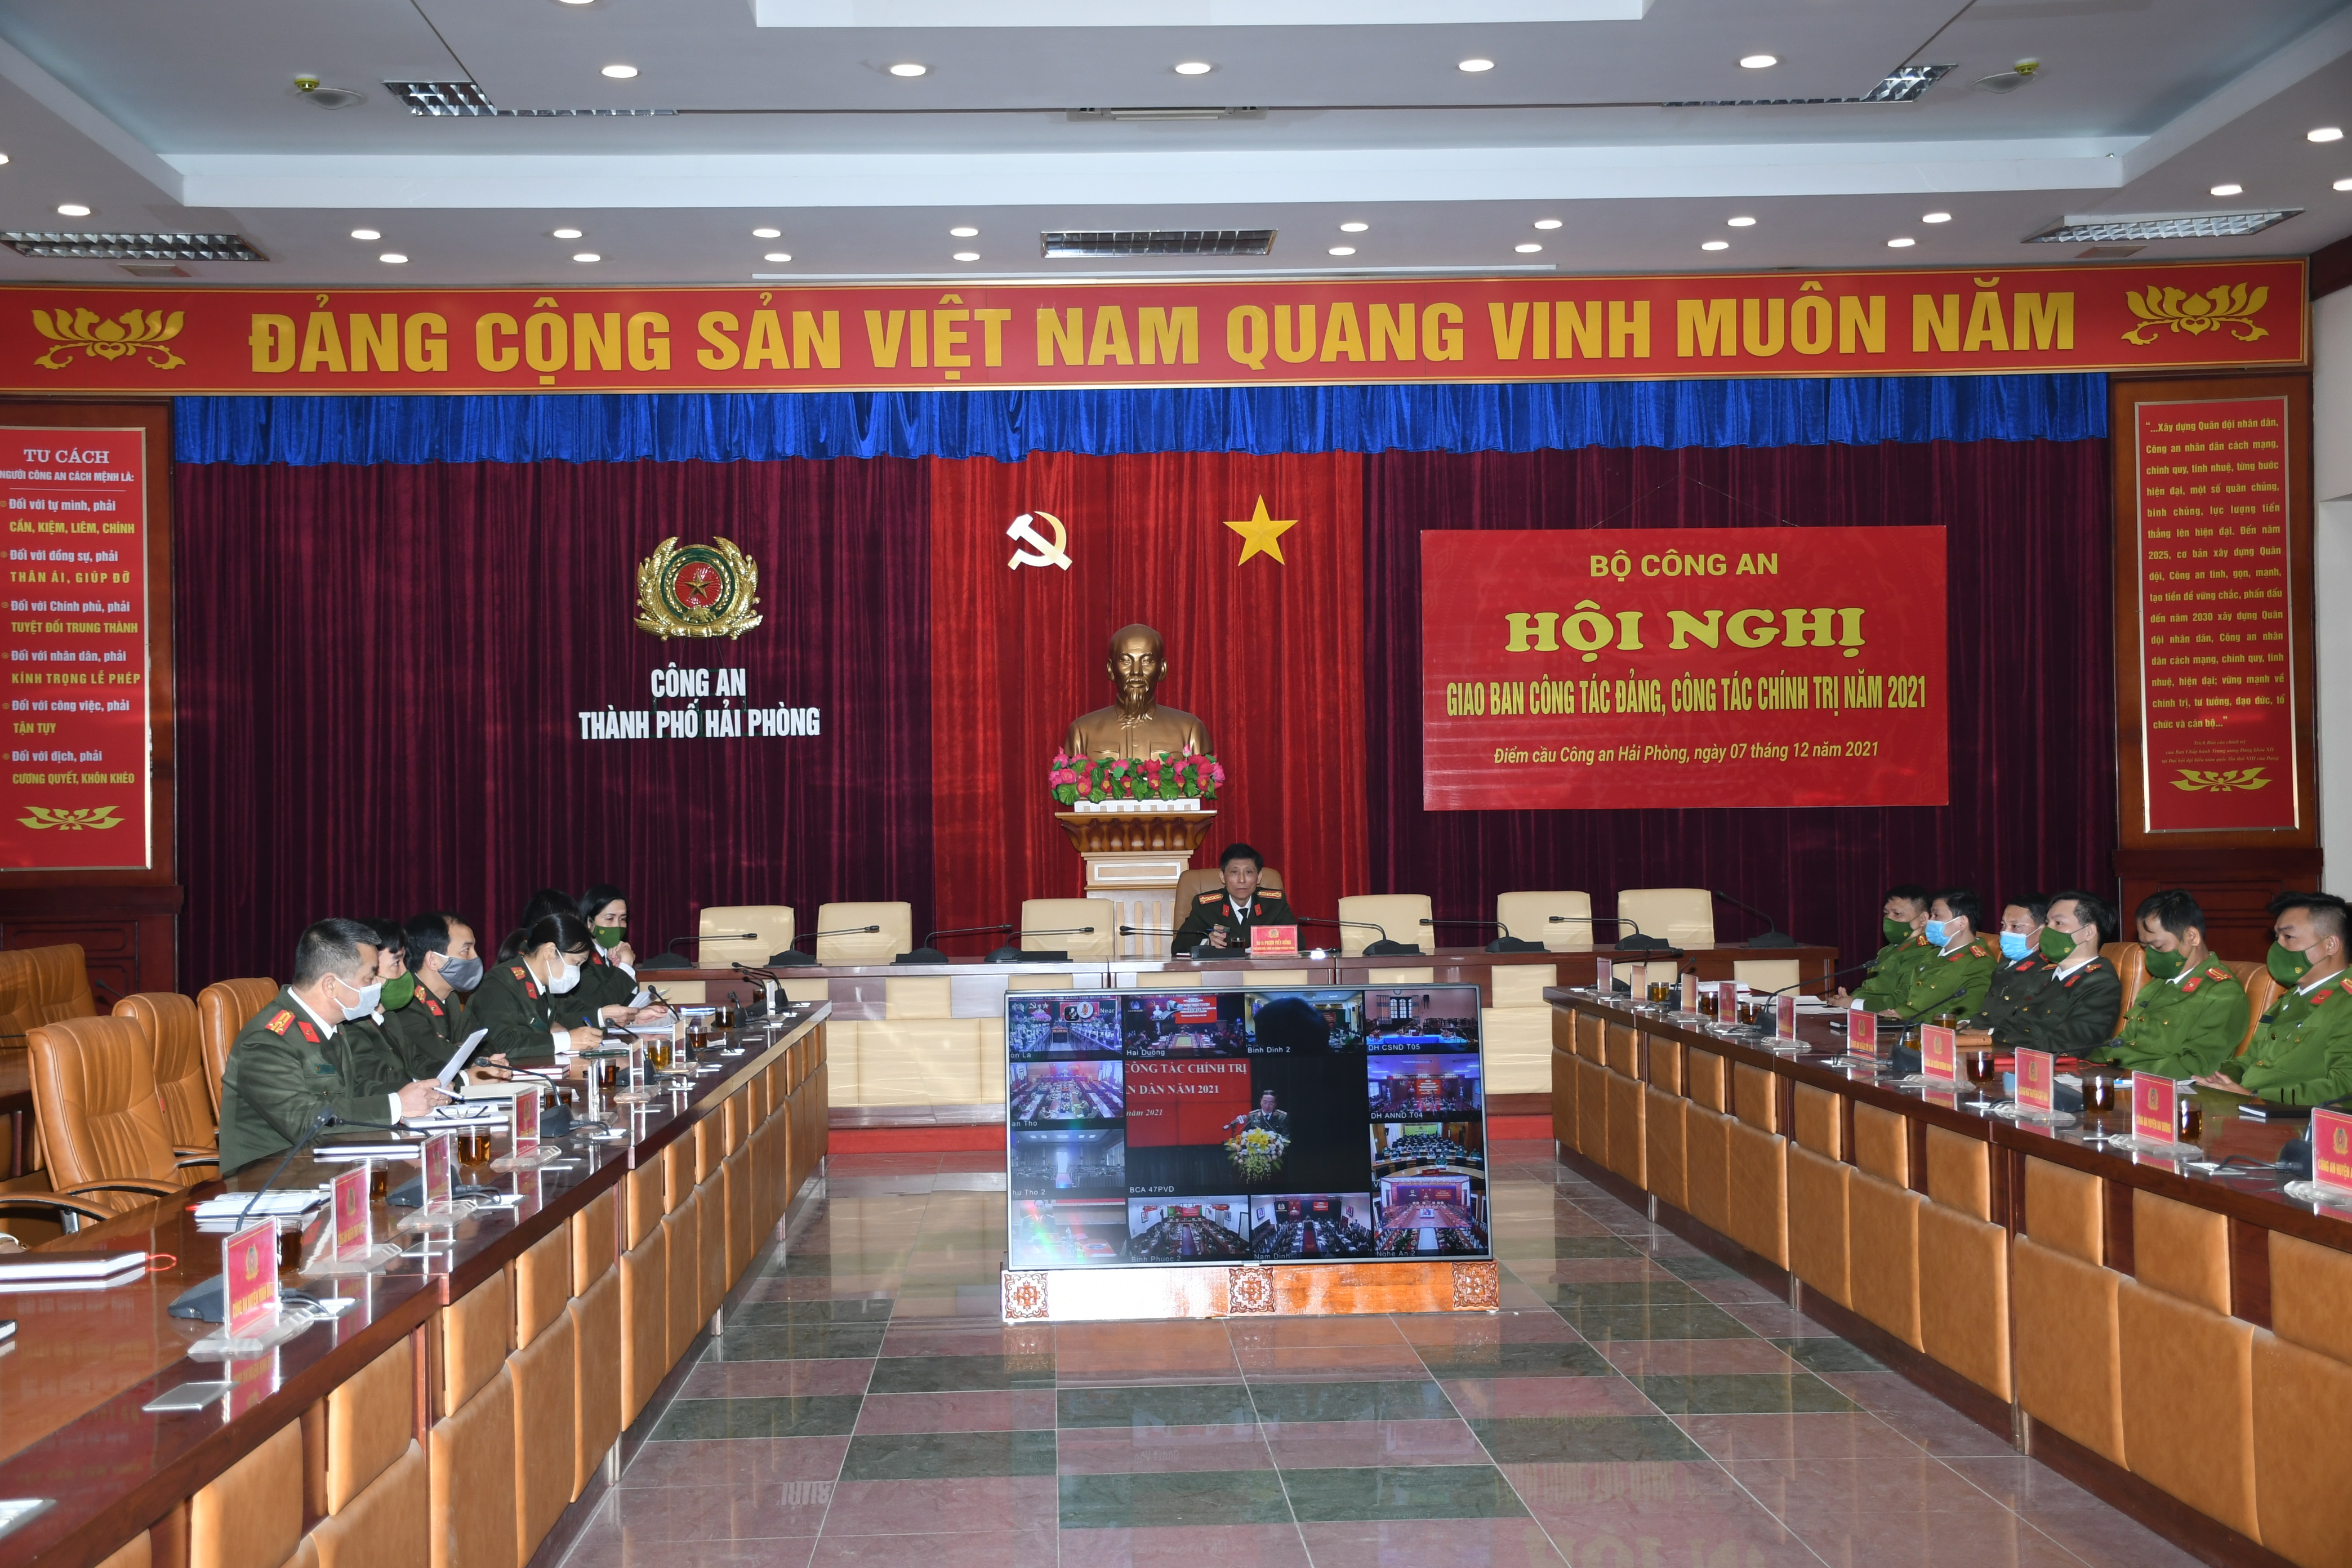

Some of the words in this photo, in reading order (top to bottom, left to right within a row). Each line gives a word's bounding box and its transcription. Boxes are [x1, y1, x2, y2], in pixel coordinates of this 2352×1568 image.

[250, 293, 447, 372] ĐẢNG
[476, 297, 670, 385] CỘNG
[697, 292, 840, 370] SẢN
[864, 294, 1011, 378] VIỆT
[1037, 306, 1199, 366] NAM
[1227, 302, 1463, 370] QUANG
[1488, 301, 1650, 359] VINH
[1677, 282, 1885, 357] MUÔN
[1913, 278, 2073, 351] NĂM
[2176, 423, 2195, 433] dựng
[2199, 421, 2219, 430] Quân
[2222, 420, 2234, 430] đội
[2238, 419, 2257, 428] nhân
[24, 449, 51, 462] TƯ
[55, 447, 109, 463] CÁCH
[28, 470, 52, 480] CÔNG
[54, 472, 66, 480] AN
[69, 471, 91, 481] CÁCH
[94, 471, 119, 483] MỆNH
[121, 471, 134, 482] LÀ:
[9, 497, 26, 509] Đối
[29, 500, 45, 510] với
[48, 500, 59, 512] tự
[61, 500, 90, 511] mình,
[93, 500, 115, 512] phải
[10, 518, 35, 533] CẦN,
[38, 520, 68, 534] KIỆM,
[71, 521, 99, 534] LIÊM,
[103, 521, 135, 533] CHÍNH
[2149, 550, 2171, 559] 2025,
[2193, 549, 2207, 558] bản
[2214, 548, 2228, 557] xây
[2234, 548, 2254, 558] dựng
[2260, 546, 2280, 556] Quân
[1591, 550, 1631, 582] BỘ
[1641, 549, 1726, 577] CÔNG
[1736, 554, 1778, 574] AN
[11, 570, 46, 582] THÂN
[51, 571, 70, 583] ÁI,
[75, 571, 108, 583] GIÚP
[113, 571, 130, 583] ĐỠ
[11, 599, 28, 611] Đối
[32, 601, 47, 611] với
[50, 601, 79, 611] Chính
[83, 600, 104, 613] phủ,
[108, 600, 130, 613] phải
[12, 620, 42, 634] TUYỆT
[46, 619, 63, 632] ĐỐI
[66, 622, 100, 633] TRUNG
[104, 621, 137, 632] THÀNH
[1505, 599, 1643, 662] HỘI
[1667, 608, 1865, 657] NGHỊ
[651, 662, 709, 697] CÔNG
[715, 668, 746, 696] AN
[1447, 682, 1485, 717] GIAO
[1490, 681, 1524, 715] BAN
[1530, 674, 1574, 715] CÔNG
[1579, 673, 1610, 714] TÁC
[1615, 672, 1665, 716] ĐẢNG,
[1672, 672, 1716, 712] CÔNG
[1721, 671, 1752, 710] TÁC
[1758, 670, 1808, 710] CHÍNH
[1813, 676, 1838, 714] TRỊ
[1845, 669, 1882, 708] NĂM
[1888, 675, 1925, 708] 2021
[579, 705, 649, 740] THÀNH
[657, 699, 698, 738] PHỐ
[706, 700, 741, 737] HẢI
[749, 702, 820, 736] PHÒNG
[2153, 720, 2173, 729] chức
[2188, 719, 2203, 728] cán
[14, 721, 34, 735] TẬN
[37, 723, 56, 735] TỤY
[12, 750, 29, 761] Đối
[33, 751, 48, 761] với
[51, 751, 77, 763] địch,
[80, 750, 102, 762] phải
[1494, 746, 1528, 763] Điểm
[1533, 746, 1556, 762] cầu
[1561, 746, 1594, 765] Công
[1598, 750, 1614, 761] an
[1619, 744, 1641, 761] Hải
[1645, 745, 1689, 764] Phòng,
[1694, 744, 1726, 763] ngày
[1730, 743, 1747, 758] 07
[1751, 742, 1788, 761] tháng
[1794, 742, 1808, 756] 12
[1813, 741, 1841, 756] năm
[1846, 741, 1878, 756] 2021
[13, 773, 45, 784] CƯƠNG
[48, 771, 78, 785] QUYẾT,
[82, 772, 107, 783] KHÔN
[110, 771, 135, 783] KHÉO
[1125, 1061, 1158, 1073] CÔNG
[1160, 1062, 1184, 1073] TÁC
[1188, 1062, 1225, 1073] CHÍNH
[1227, 1064, 1247, 1074] TRỊ
[1139, 1083, 1164, 1094] DÂN
[1168, 1083, 1195, 1094] NĂM
[1197, 1085, 1219, 1094] 2021
